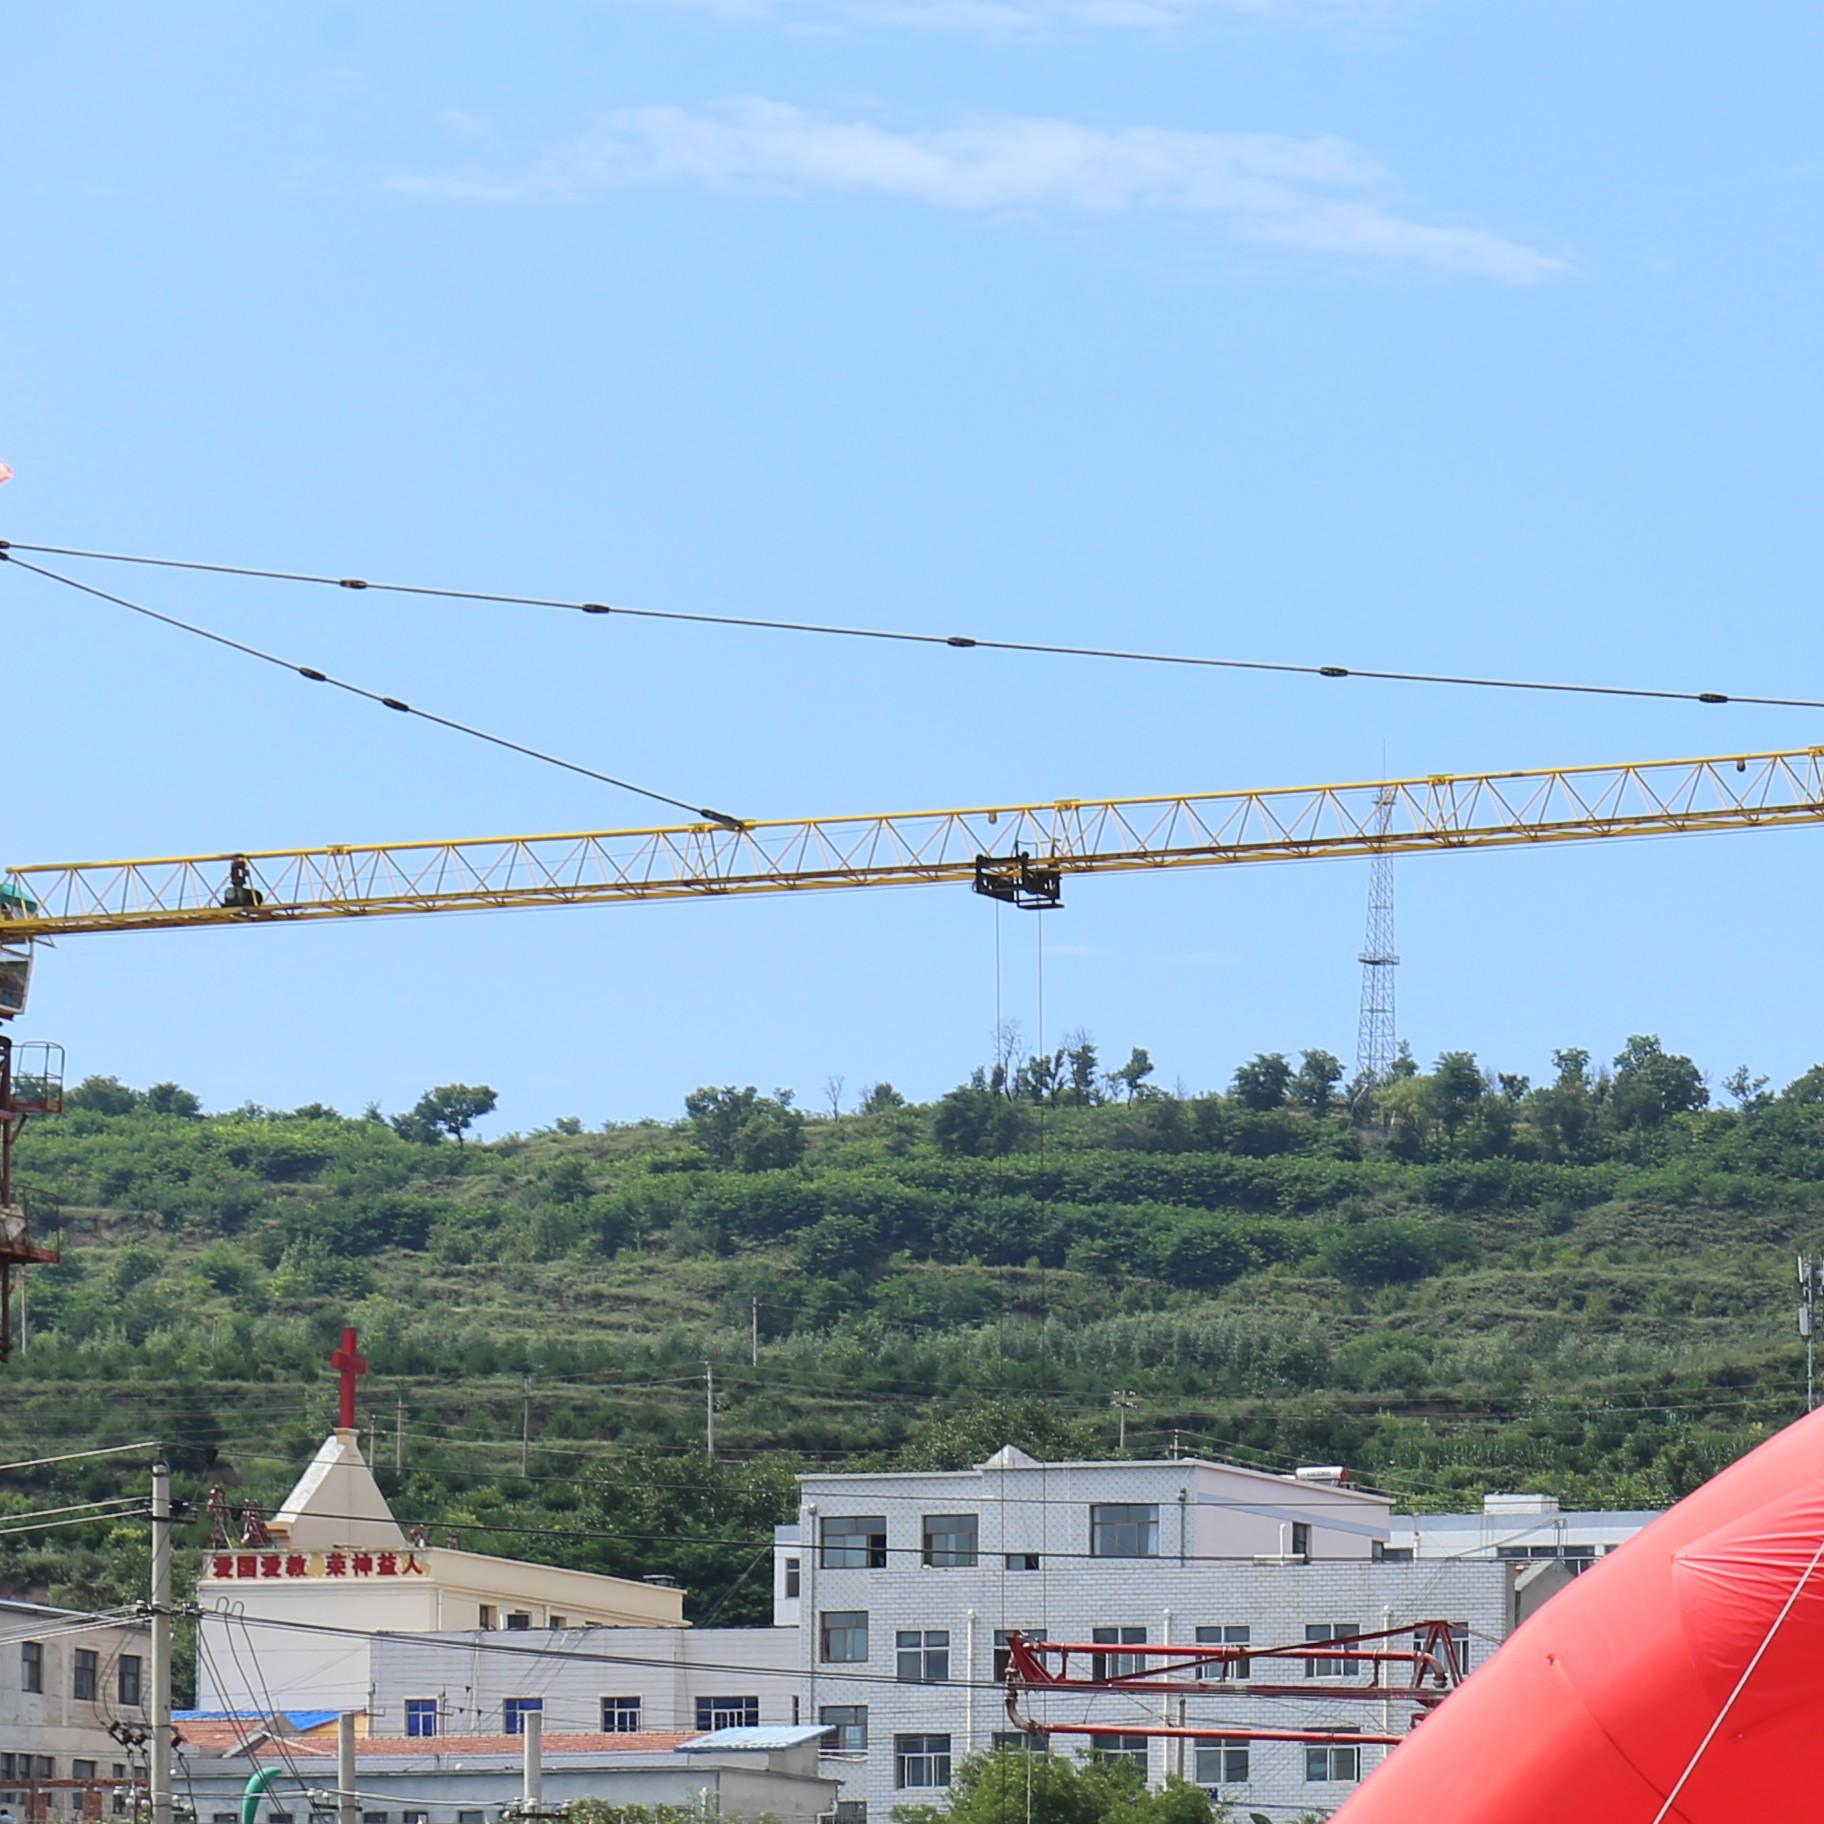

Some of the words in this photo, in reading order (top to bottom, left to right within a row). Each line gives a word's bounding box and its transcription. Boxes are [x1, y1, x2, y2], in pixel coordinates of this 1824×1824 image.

[213, 1555, 307, 1578] 爱国爱教
[326, 1553, 422, 1576] 荣神益人
